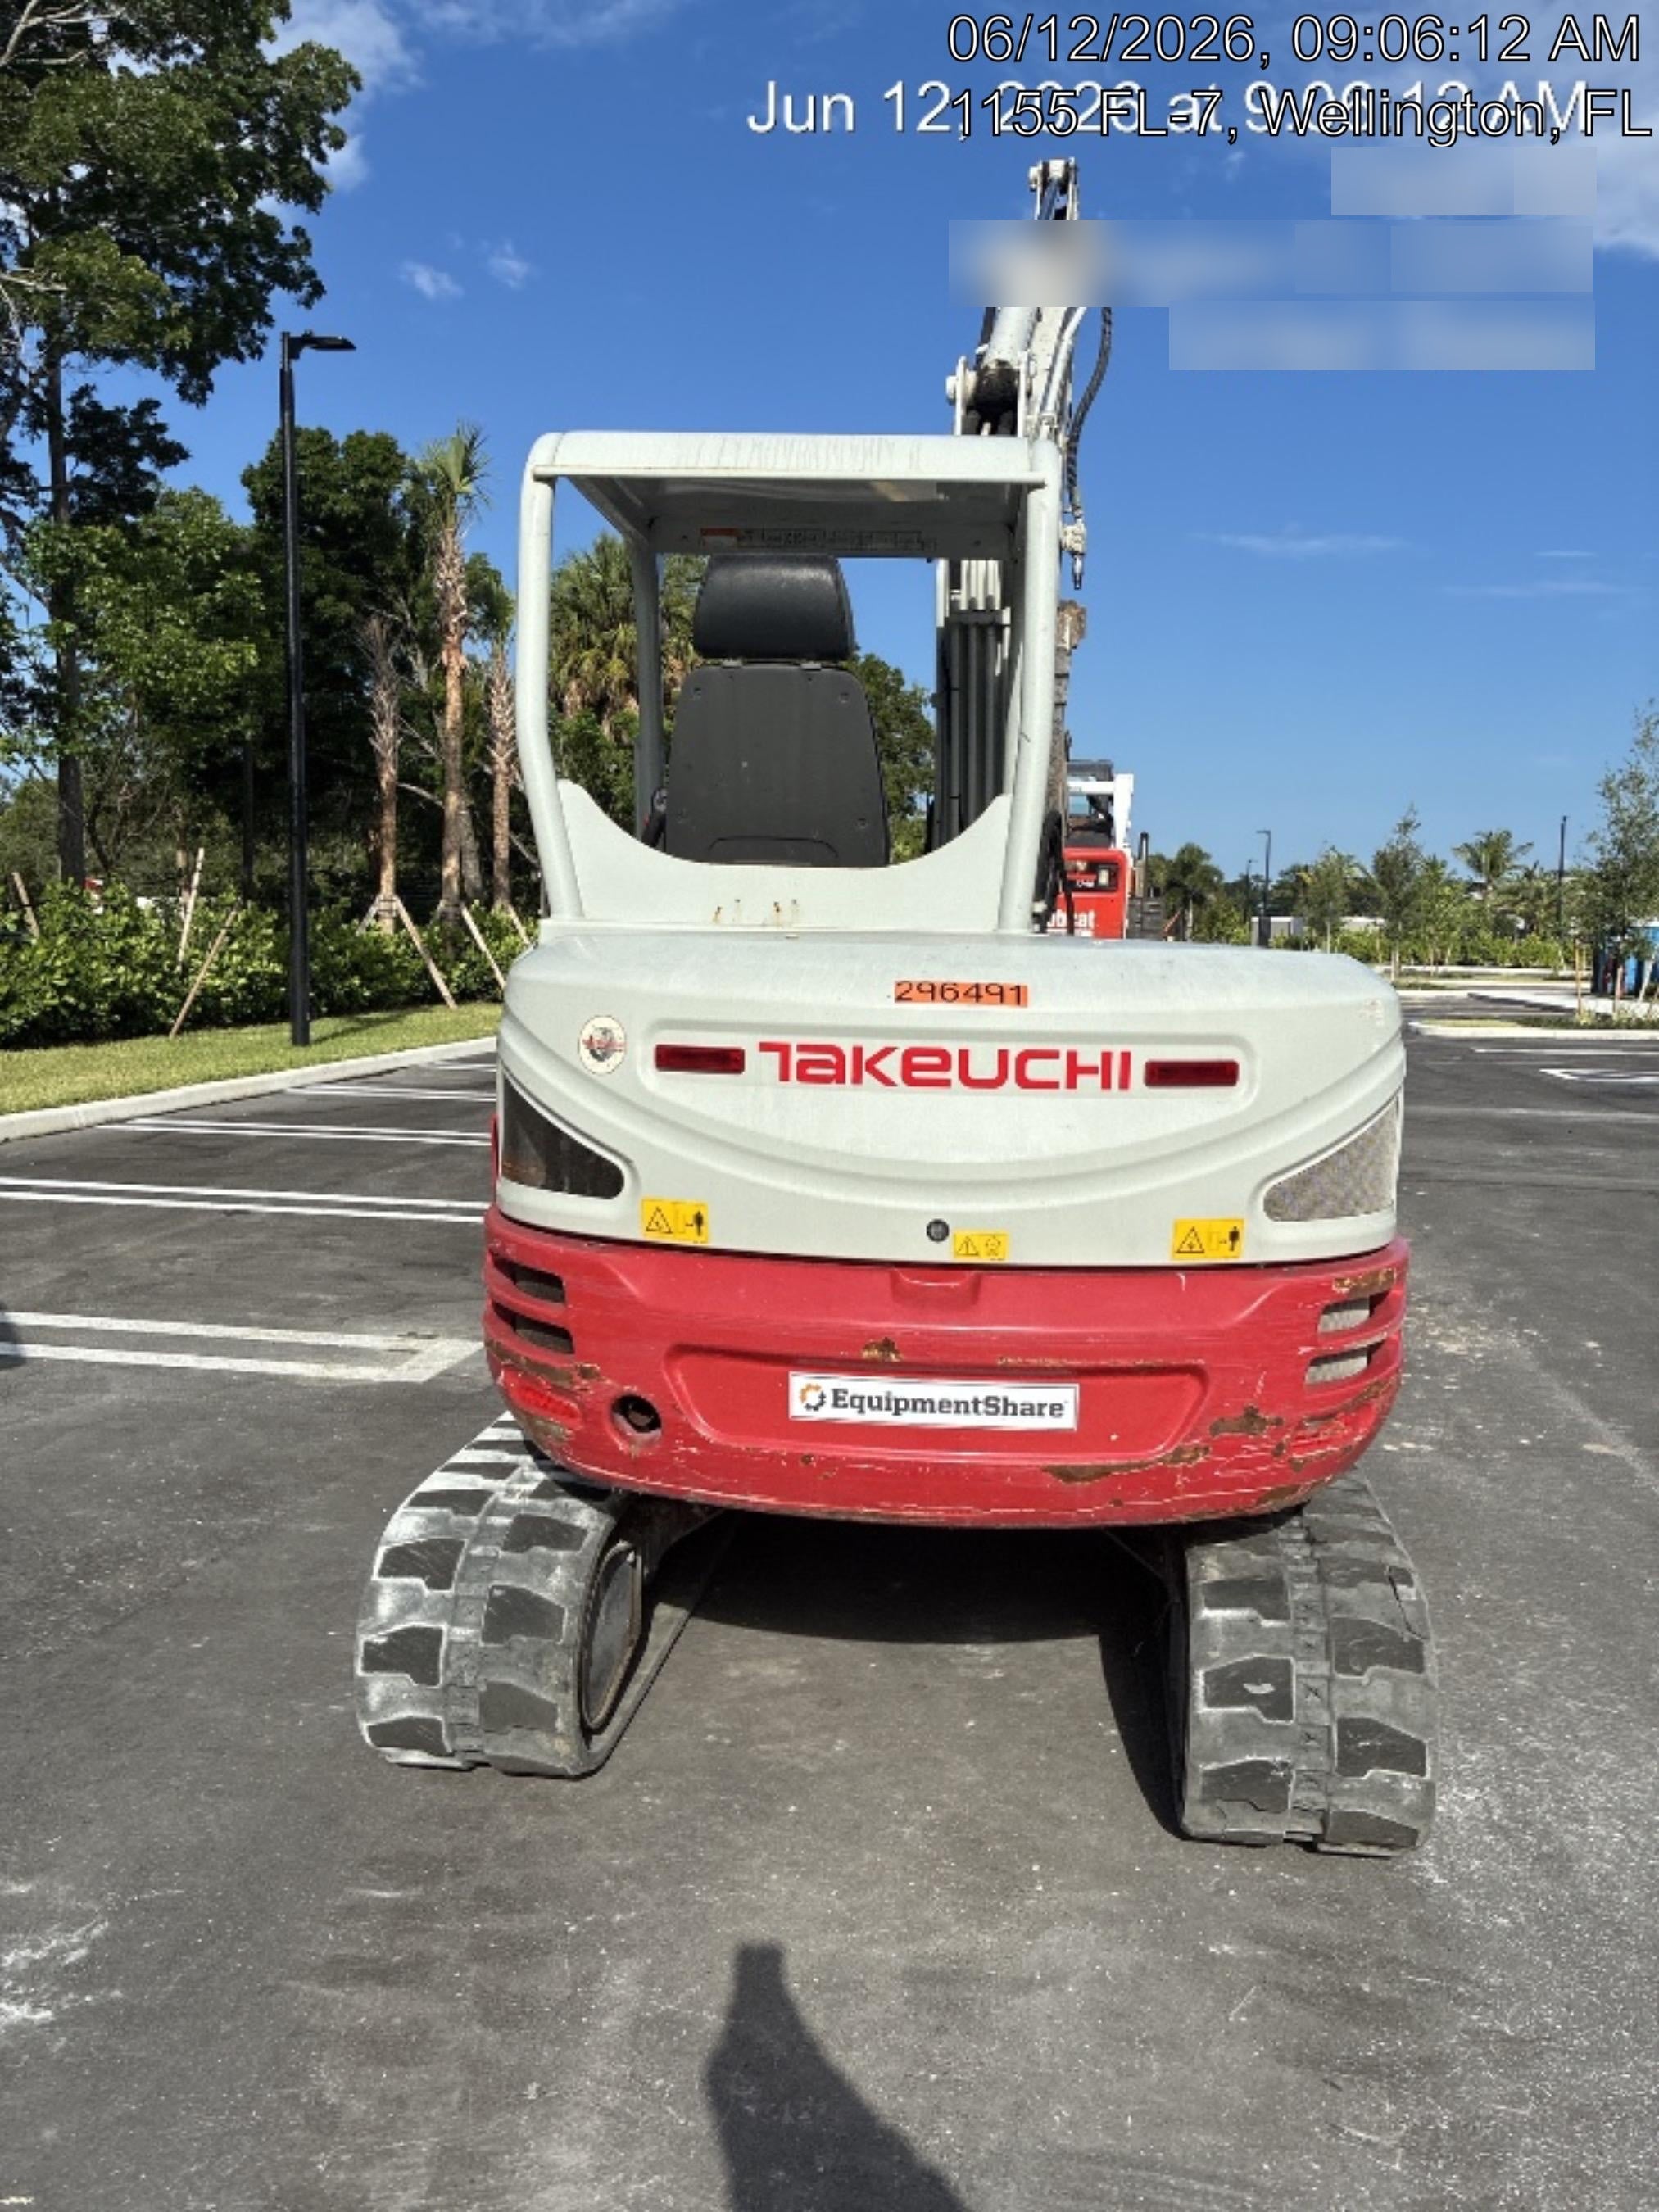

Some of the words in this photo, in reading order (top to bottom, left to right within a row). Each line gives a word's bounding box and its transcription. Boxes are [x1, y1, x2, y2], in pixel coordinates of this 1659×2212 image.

[1047, 909, 1095, 929] obat
[895, 981, 1023, 1006] 296491
[832, 1387, 1065, 1418] EquipmentShare
